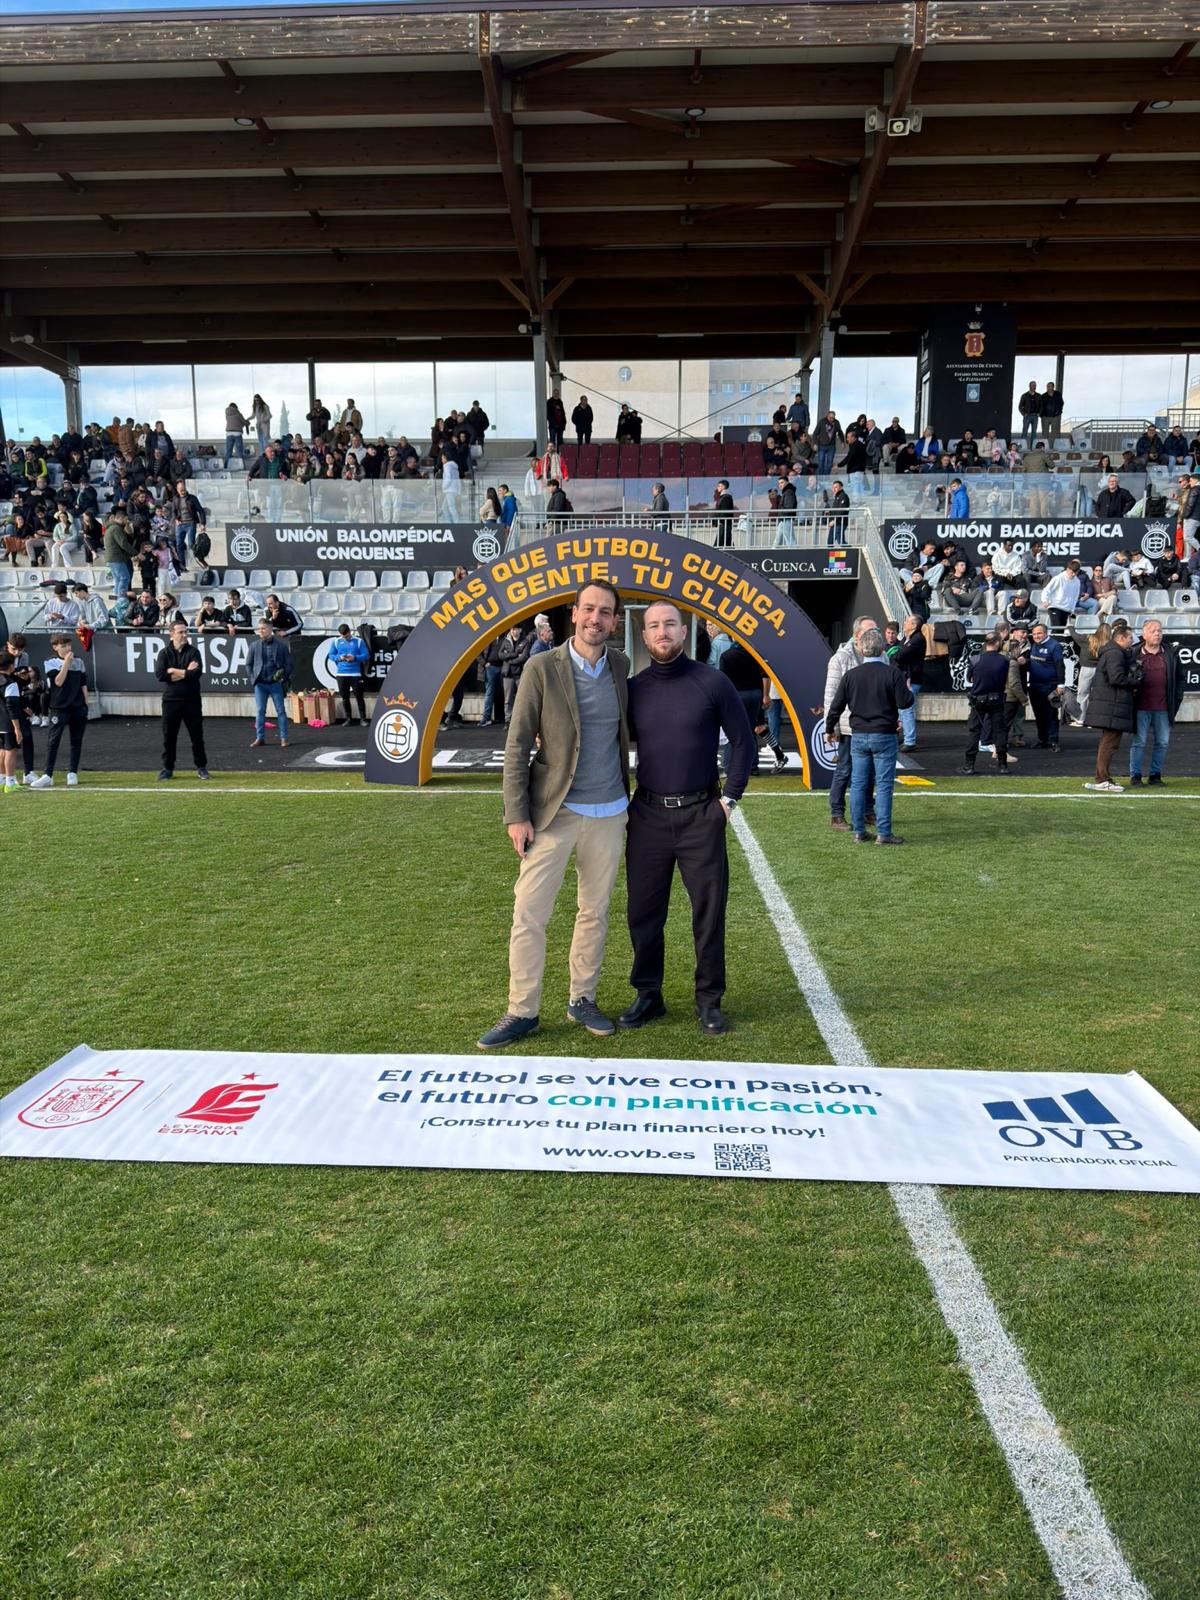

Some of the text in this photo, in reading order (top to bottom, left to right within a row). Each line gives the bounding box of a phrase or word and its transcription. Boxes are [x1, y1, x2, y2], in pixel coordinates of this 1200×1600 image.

[275, 526, 455, 543] UNIÓN BALOMPÉDICA
[936, 520, 1124, 538] UNIÓN BALOMPÉDICA
[316, 547, 415, 561] CONQUENSE
[761, 558, 817, 573] CUENCA
[431, 538, 786, 637] MAS QUE FUTBOL, CUENCA,
[460, 561, 759, 637] TU GENTE, TU CLUB
[377, 1069, 883, 1097] El futbol se vive con pasión,
[377, 1089, 878, 1116] el futuro con planificación
[420, 1116, 826, 1139] ¡Construye tu plan financiero hoy!
[998, 1125, 1143, 1151] OVB
[542, 1146, 696, 1160] www.ovb.es
[1003, 1154, 1178, 1168] PATROCINADOR OFICIAL
